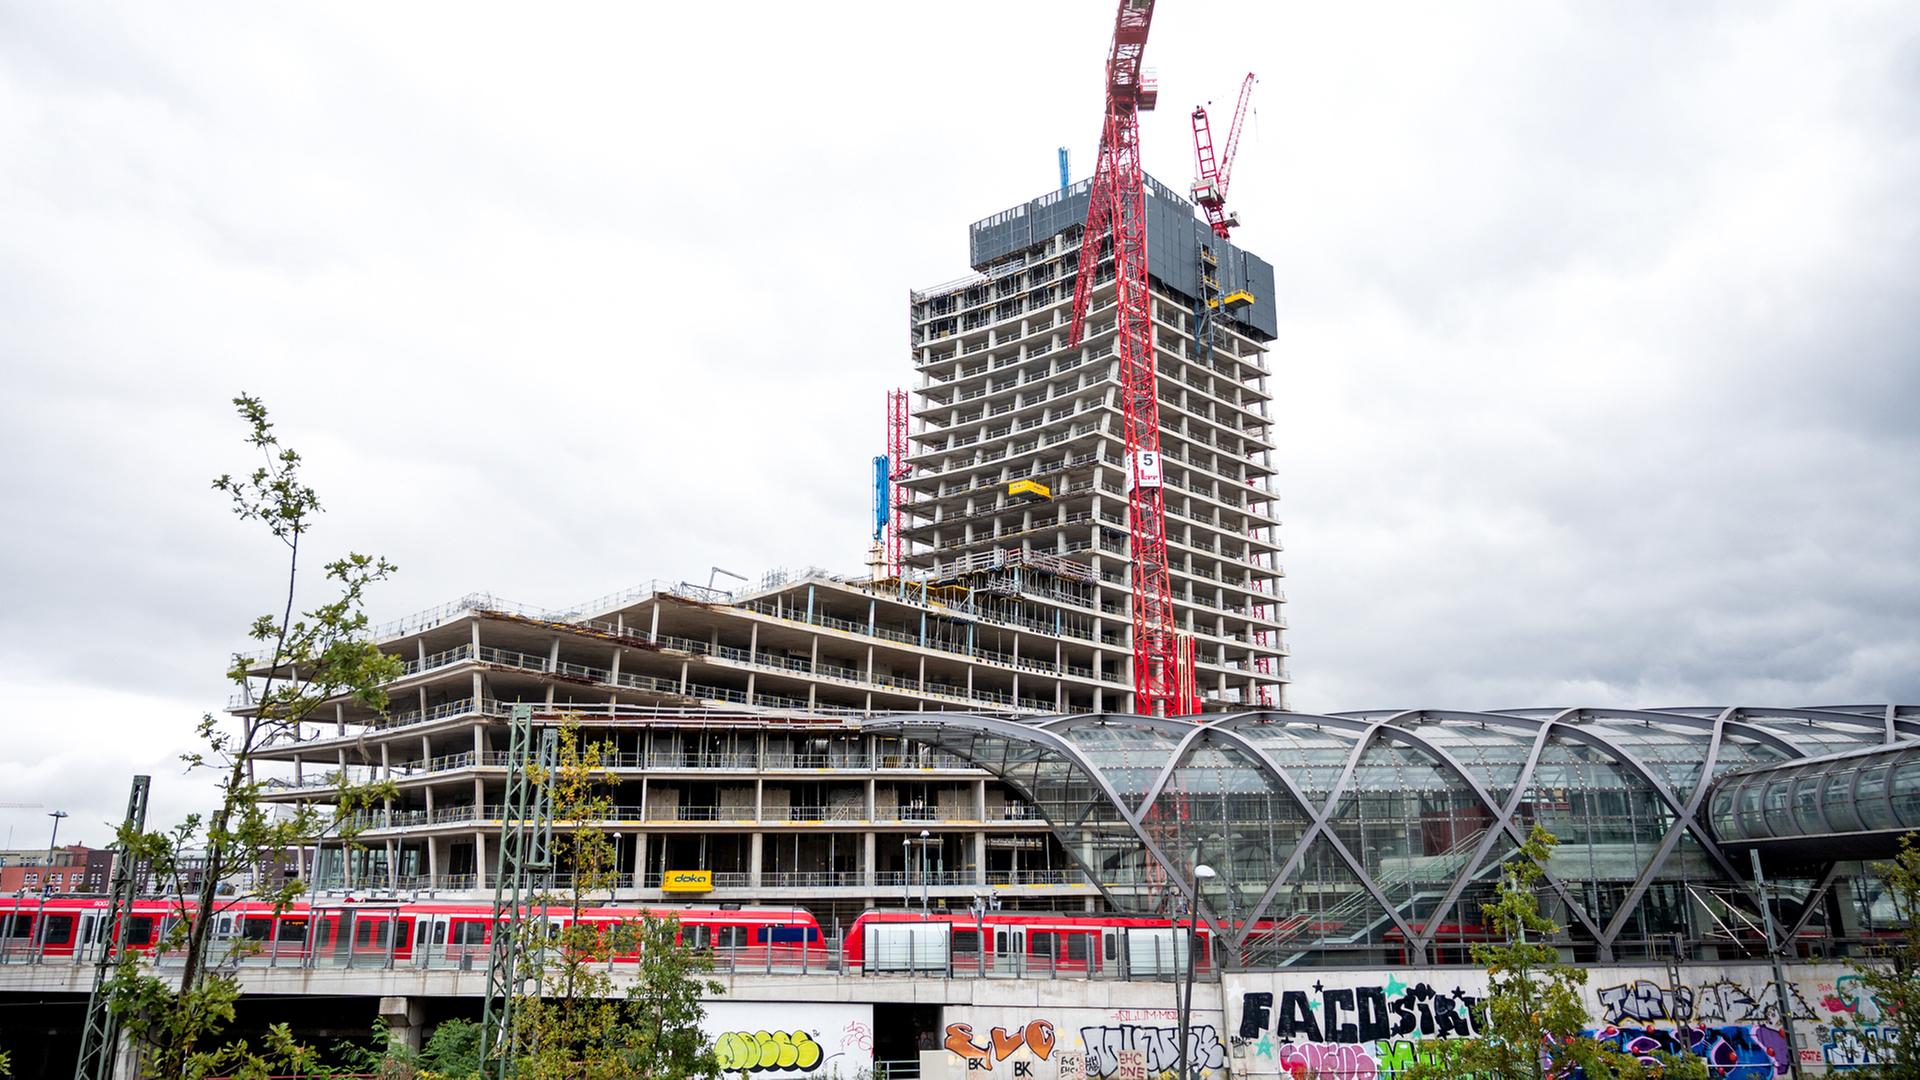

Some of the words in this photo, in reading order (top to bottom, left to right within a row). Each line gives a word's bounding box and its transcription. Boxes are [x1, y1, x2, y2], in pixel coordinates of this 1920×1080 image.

[1143, 453, 1154, 467] 5
[674, 873, 706, 883] doka
[968, 1057, 986, 1070] BK
[1014, 1061, 1033, 1077] BK
